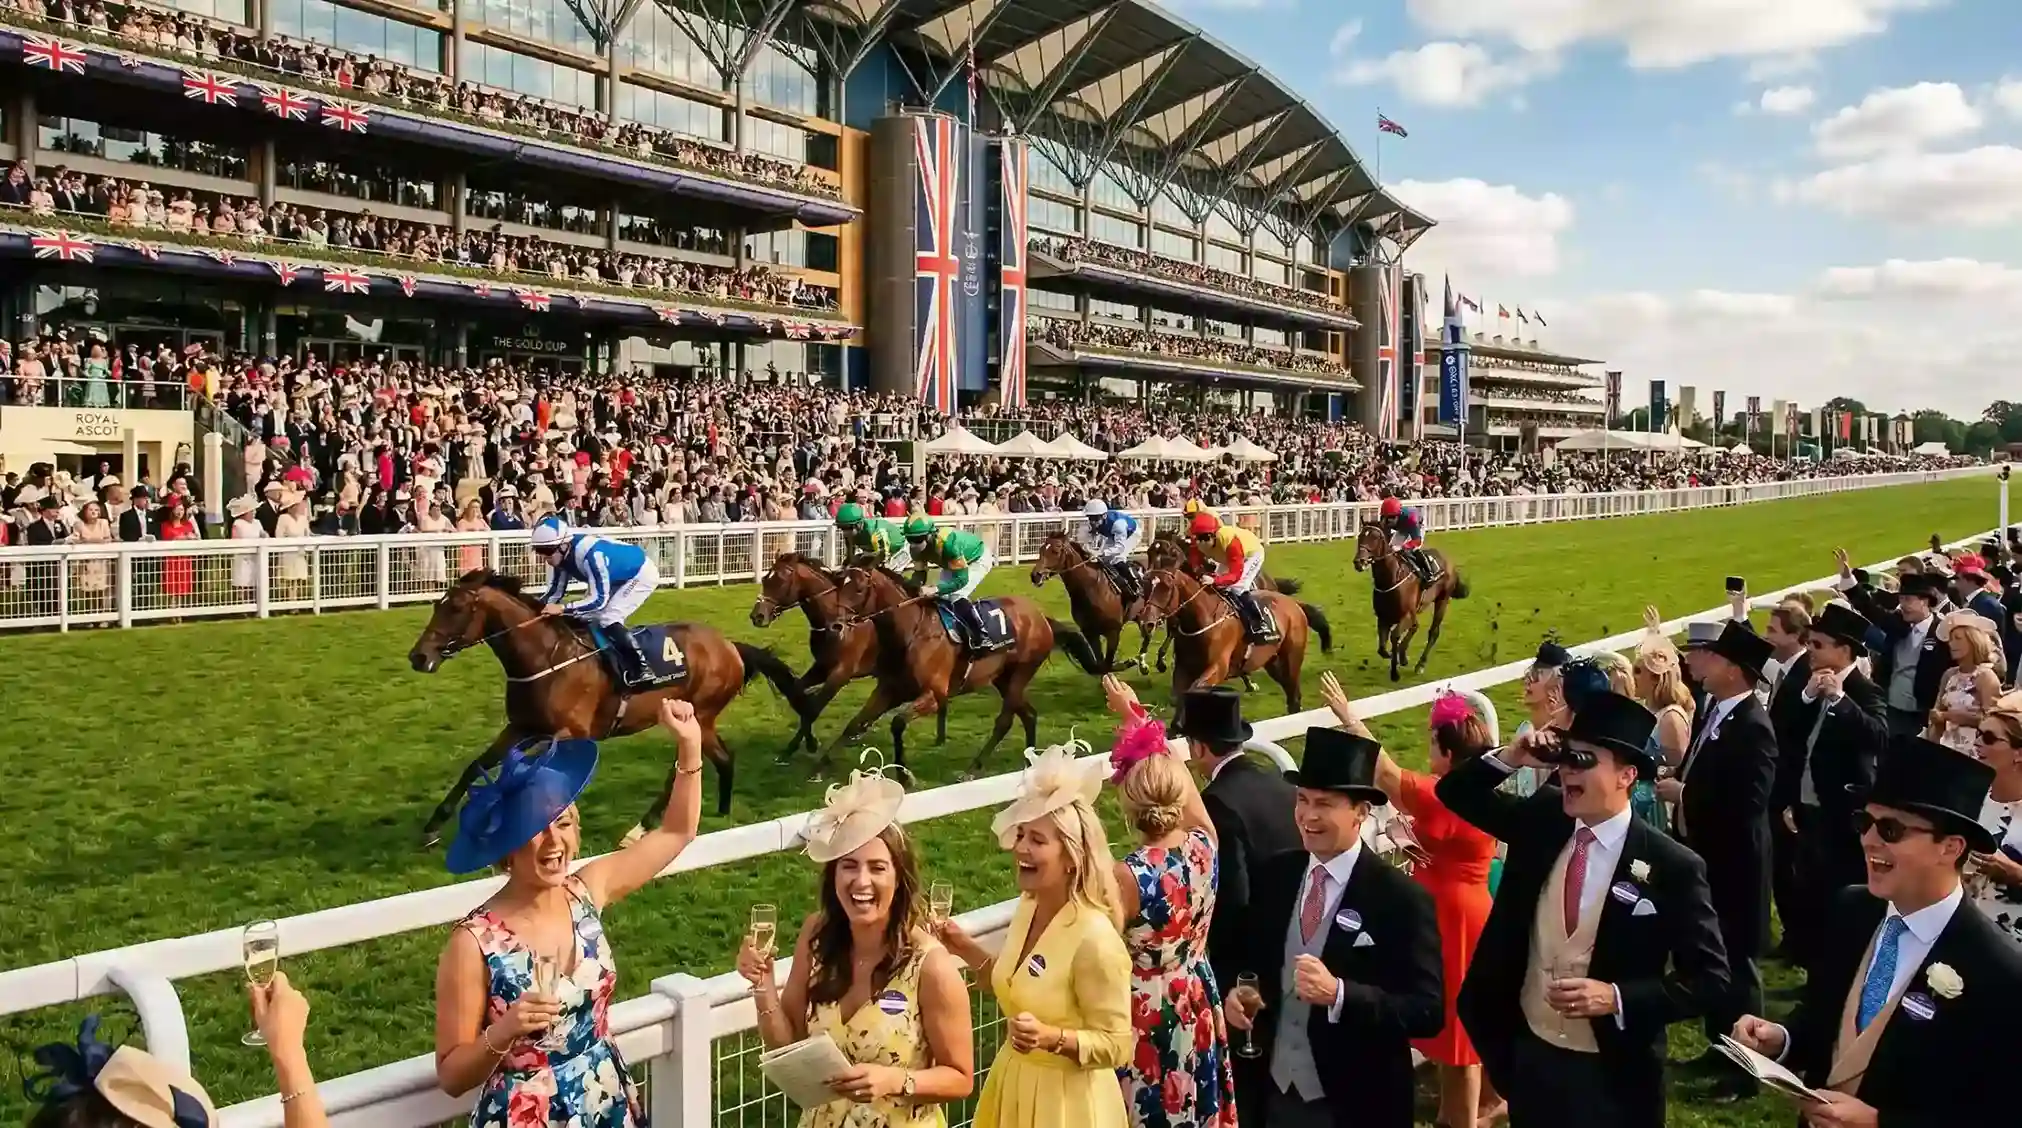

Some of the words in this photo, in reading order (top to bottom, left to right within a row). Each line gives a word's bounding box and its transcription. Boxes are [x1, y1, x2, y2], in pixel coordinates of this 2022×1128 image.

[493, 336, 513, 348] THE
[515, 339, 543, 350] GOLD
[545, 340, 567, 352] CUP
[76, 413, 119, 424] ROYAL
[76, 425, 118, 436] ASCOT
[988, 608, 1007, 635] 7
[663, 636, 684, 667] 4
